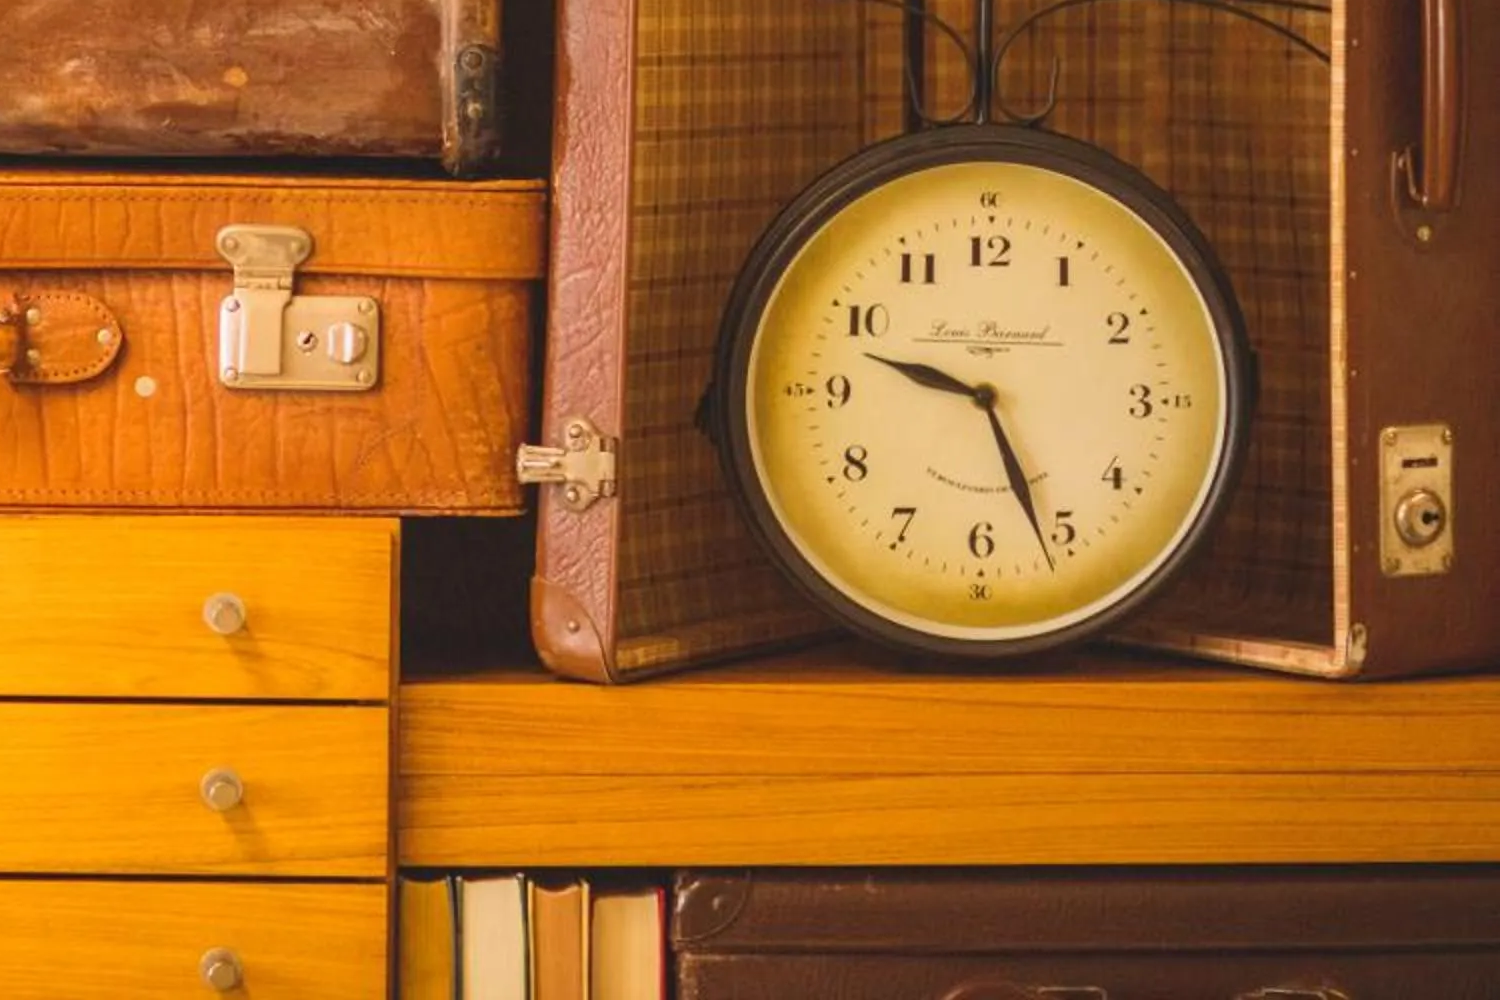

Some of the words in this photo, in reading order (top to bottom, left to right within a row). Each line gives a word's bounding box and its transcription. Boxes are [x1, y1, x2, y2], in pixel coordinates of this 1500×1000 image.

[900, 252, 937, 285] 11
[969, 235, 1012, 268] 12
[1056, 255, 1073, 288] 1
[848, 303, 889, 338] 10
[1106, 311, 1131, 345] 2
[825, 374, 852, 409] 9
[1127, 383, 1154, 419] 3
[842, 445, 869, 482] 8
[1101, 455, 1125, 491] 4
[891, 506, 917, 544] 7
[968, 521, 996, 560] 6
[1051, 510, 1077, 545] 5
